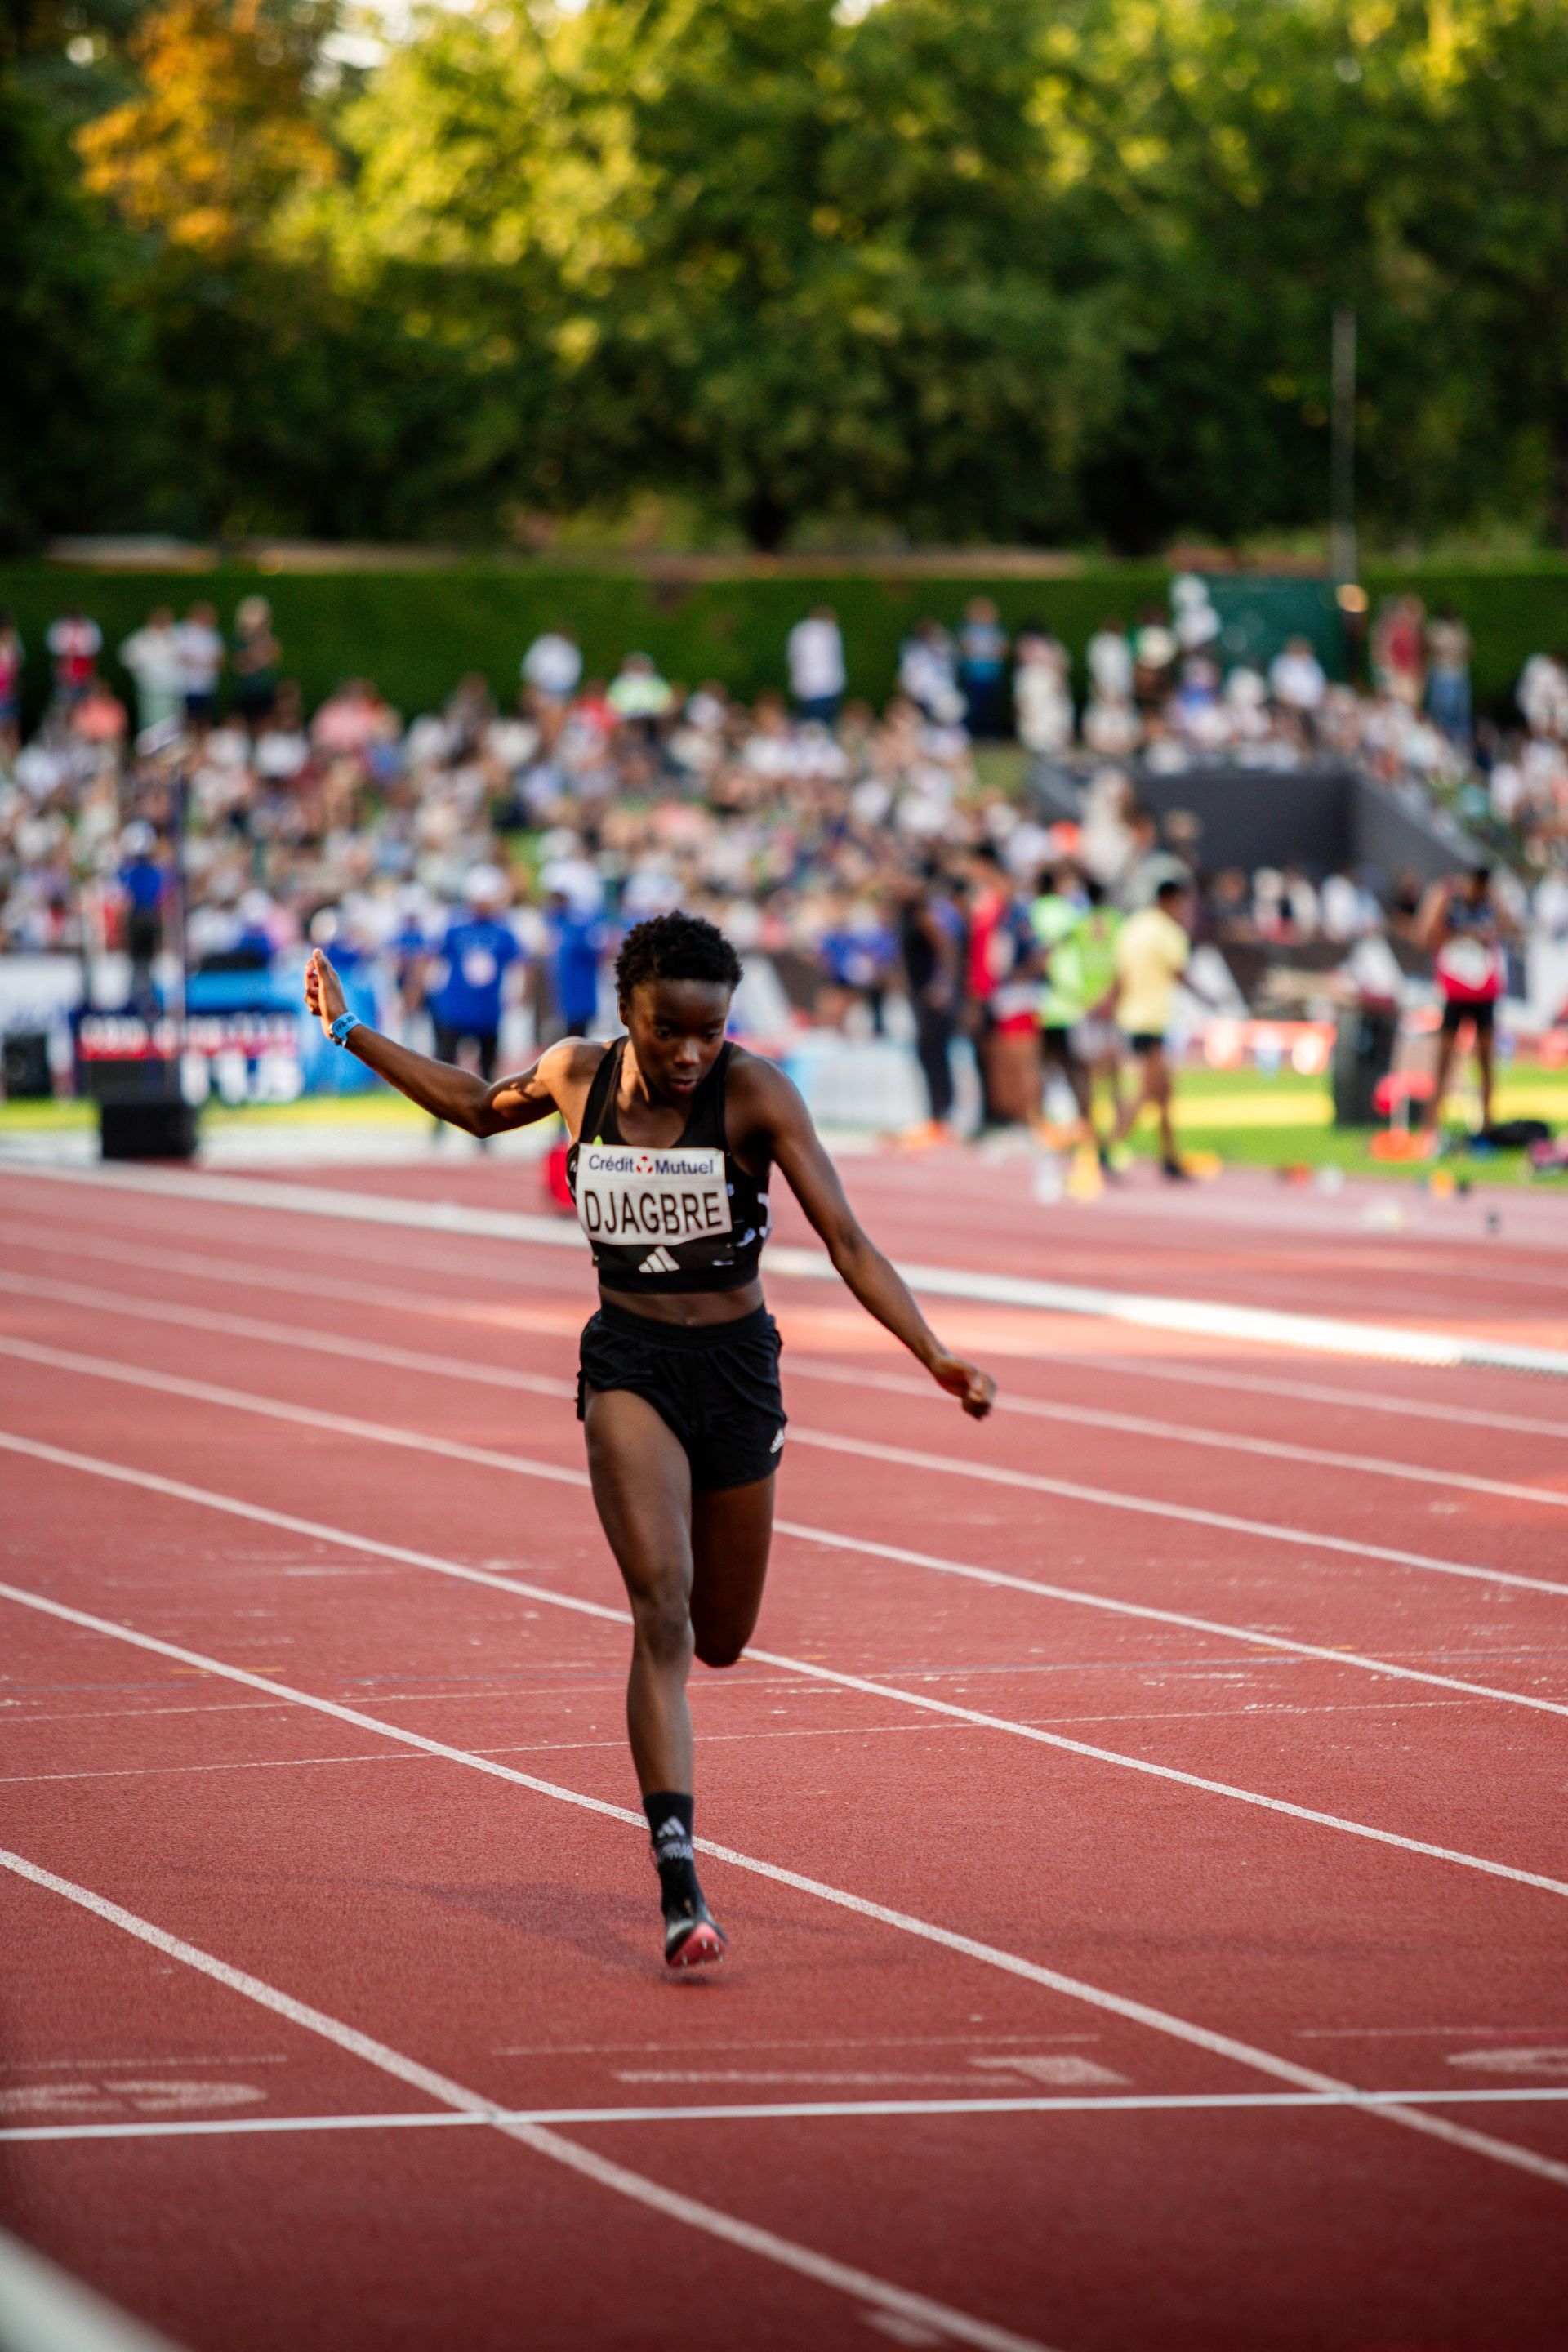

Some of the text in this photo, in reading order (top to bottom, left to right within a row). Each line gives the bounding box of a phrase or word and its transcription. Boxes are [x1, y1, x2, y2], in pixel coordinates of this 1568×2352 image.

[589, 1155, 714, 1174] Crédit Mutuel
[584, 1189, 722, 1235] DJAGBRE
